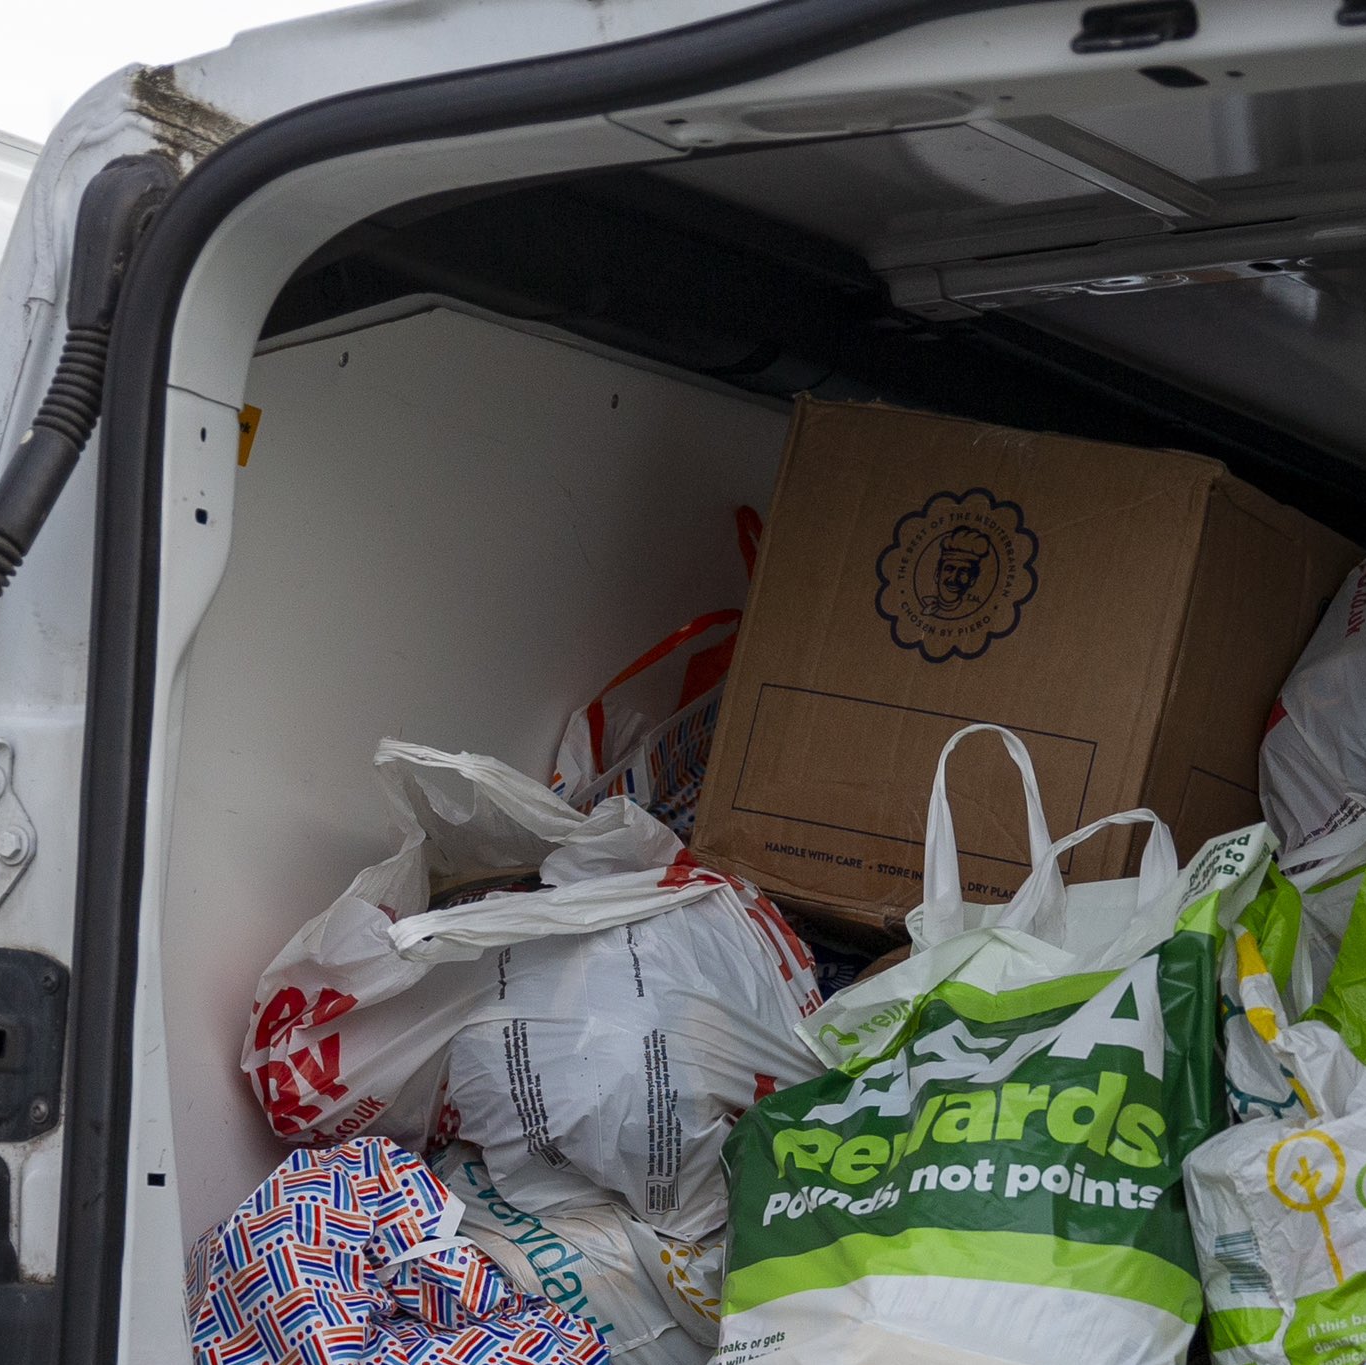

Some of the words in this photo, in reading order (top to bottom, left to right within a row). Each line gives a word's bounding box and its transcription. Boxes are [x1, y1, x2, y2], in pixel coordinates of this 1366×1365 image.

[898, 557, 909, 580] THE
[908, 529, 928, 554] BEST
[931, 517, 945, 529] OF
[950, 512, 971, 522] THE
[974, 513, 1016, 598] MEDITERRANEAN
[958, 615, 991, 638] PIERO
[765, 842, 806, 858] HANDLE
[808, 849, 833, 864] WITH
[836, 855, 863, 869] CARE
[877, 864, 910, 880] STORE
[912, 871, 923, 881] IN
[1225, 848, 1245, 862] to
[968, 882, 988, 894] DRY
[990, 886, 1016, 899] PLAC
[503, 1039, 514, 1060] plastic
[643, 1050, 654, 1072] plastic
[506, 1060, 518, 1086] recycled
[653, 1049, 663, 1080] packaging
[645, 1072, 655, 1098] recycled
[655, 1081, 664, 1110] recovered
[908, 1159, 995, 1194] not
[1004, 1161, 1164, 1211] points
[1319, 1318, 1348, 1334] this
[750, 1338, 763, 1350] or
[763, 1331, 786, 1348] gets
